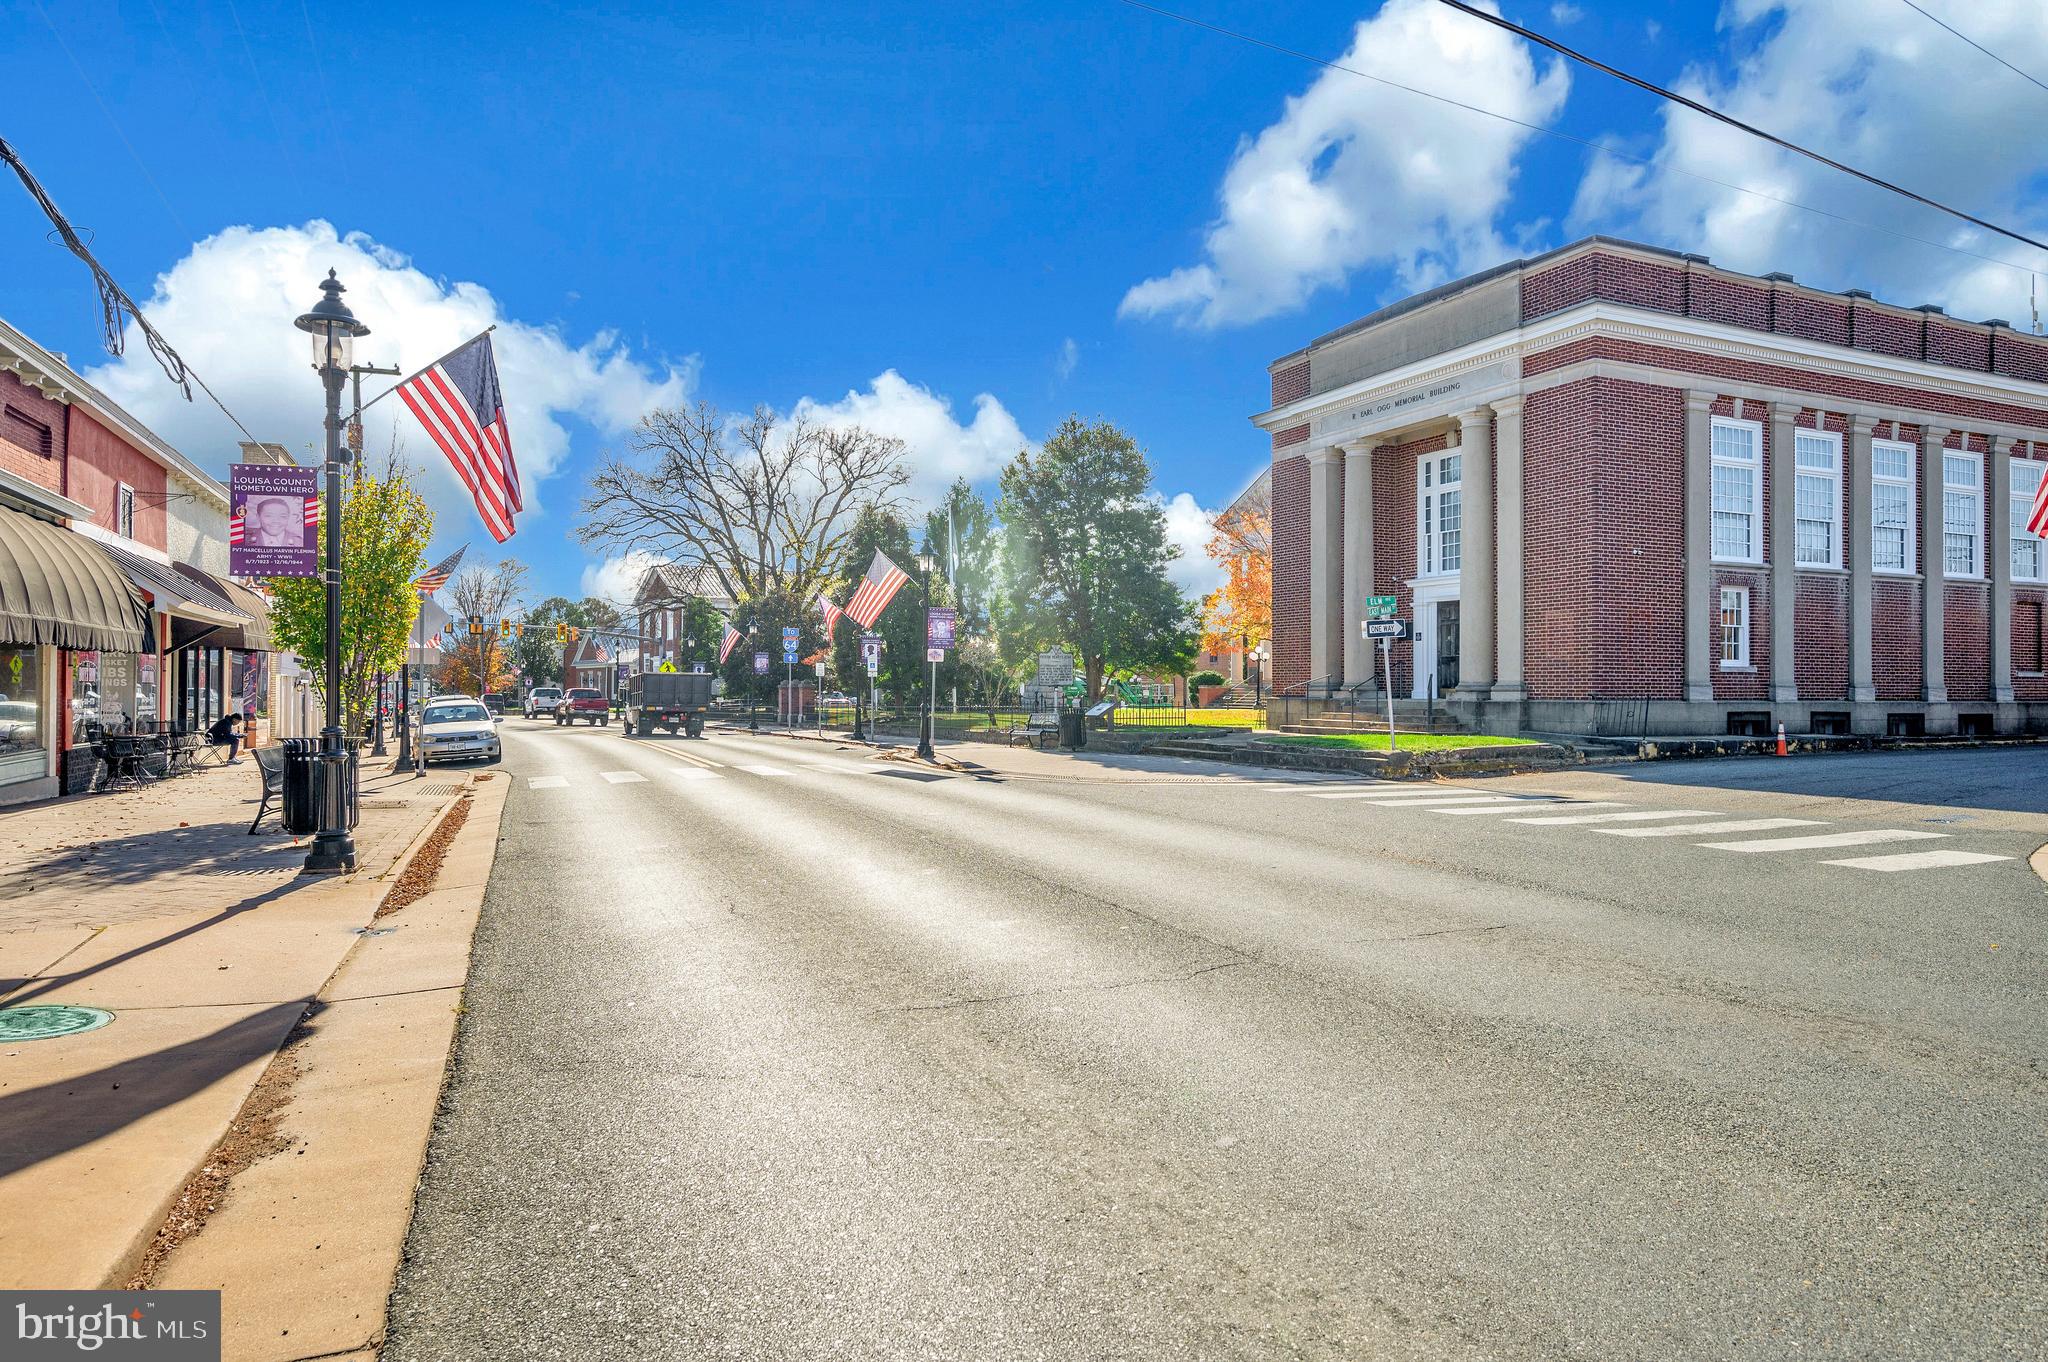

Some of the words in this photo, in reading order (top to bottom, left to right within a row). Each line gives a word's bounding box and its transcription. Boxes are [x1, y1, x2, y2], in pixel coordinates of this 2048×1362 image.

[1360, 409, 1374, 417] EARL
[1377, 404, 1391, 412] OGG
[1394, 393, 1425, 407] MEMORIAL
[1429, 382, 1461, 397] BUILDING
[234, 476, 271, 485] LOUISA
[273, 478, 314, 486] COUNTY
[234, 484, 288, 492] HOMETOWN
[290, 486, 314, 494] HERO
[1370, 597, 1383, 605] ELM
[1368, 607, 1379, 616] EAST
[1380, 606, 1391, 614] MAIN
[785, 640, 796, 650] 64
